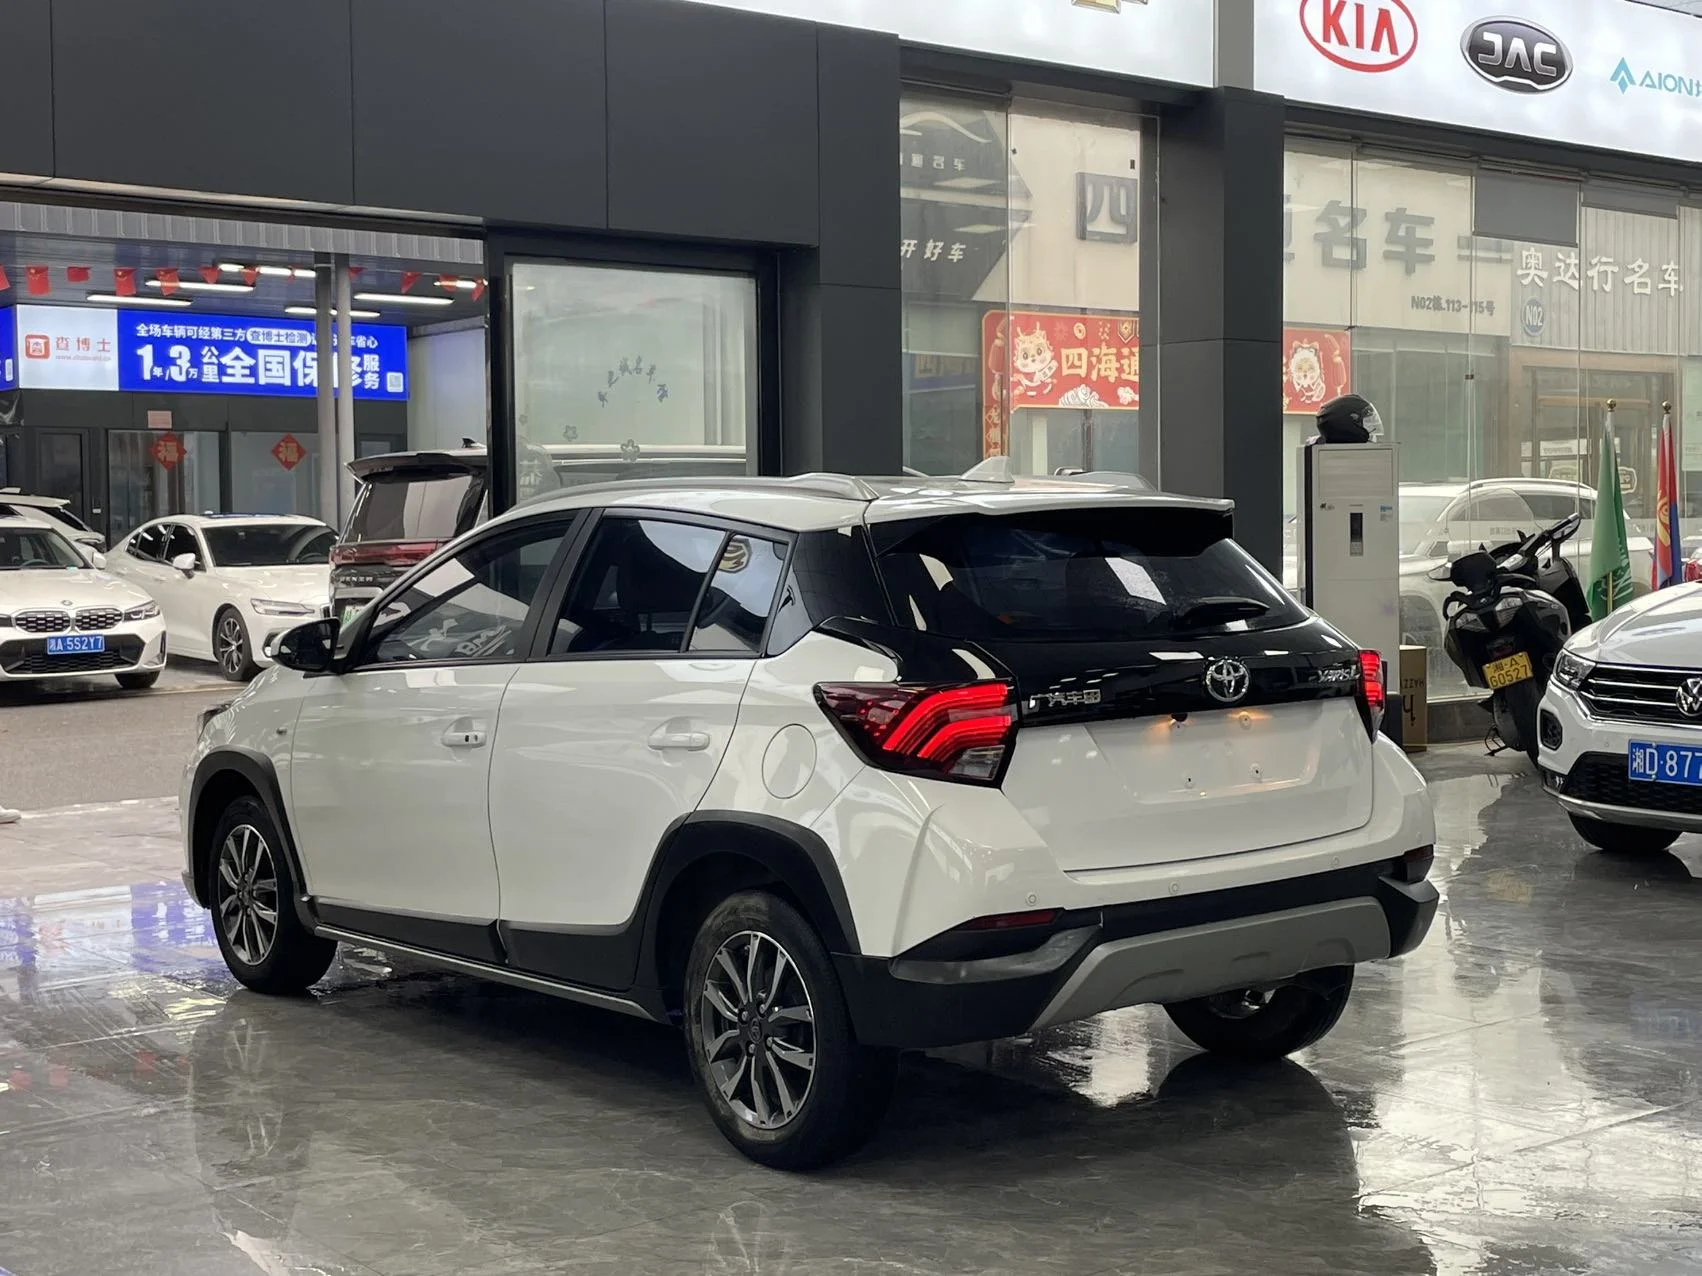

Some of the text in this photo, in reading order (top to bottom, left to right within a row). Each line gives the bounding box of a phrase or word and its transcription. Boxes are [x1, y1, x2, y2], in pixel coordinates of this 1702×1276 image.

[1323, 0, 1399, 56] KIA
[1478, 31, 1557, 77] JAC
[1639, 70, 1694, 96] AION
[1075, 171, 1138, 244] 四
[1284, 193, 1436, 276] 名车
[1516, 247, 1684, 297] 奥达行名车
[55, 335, 111, 353] 查博士
